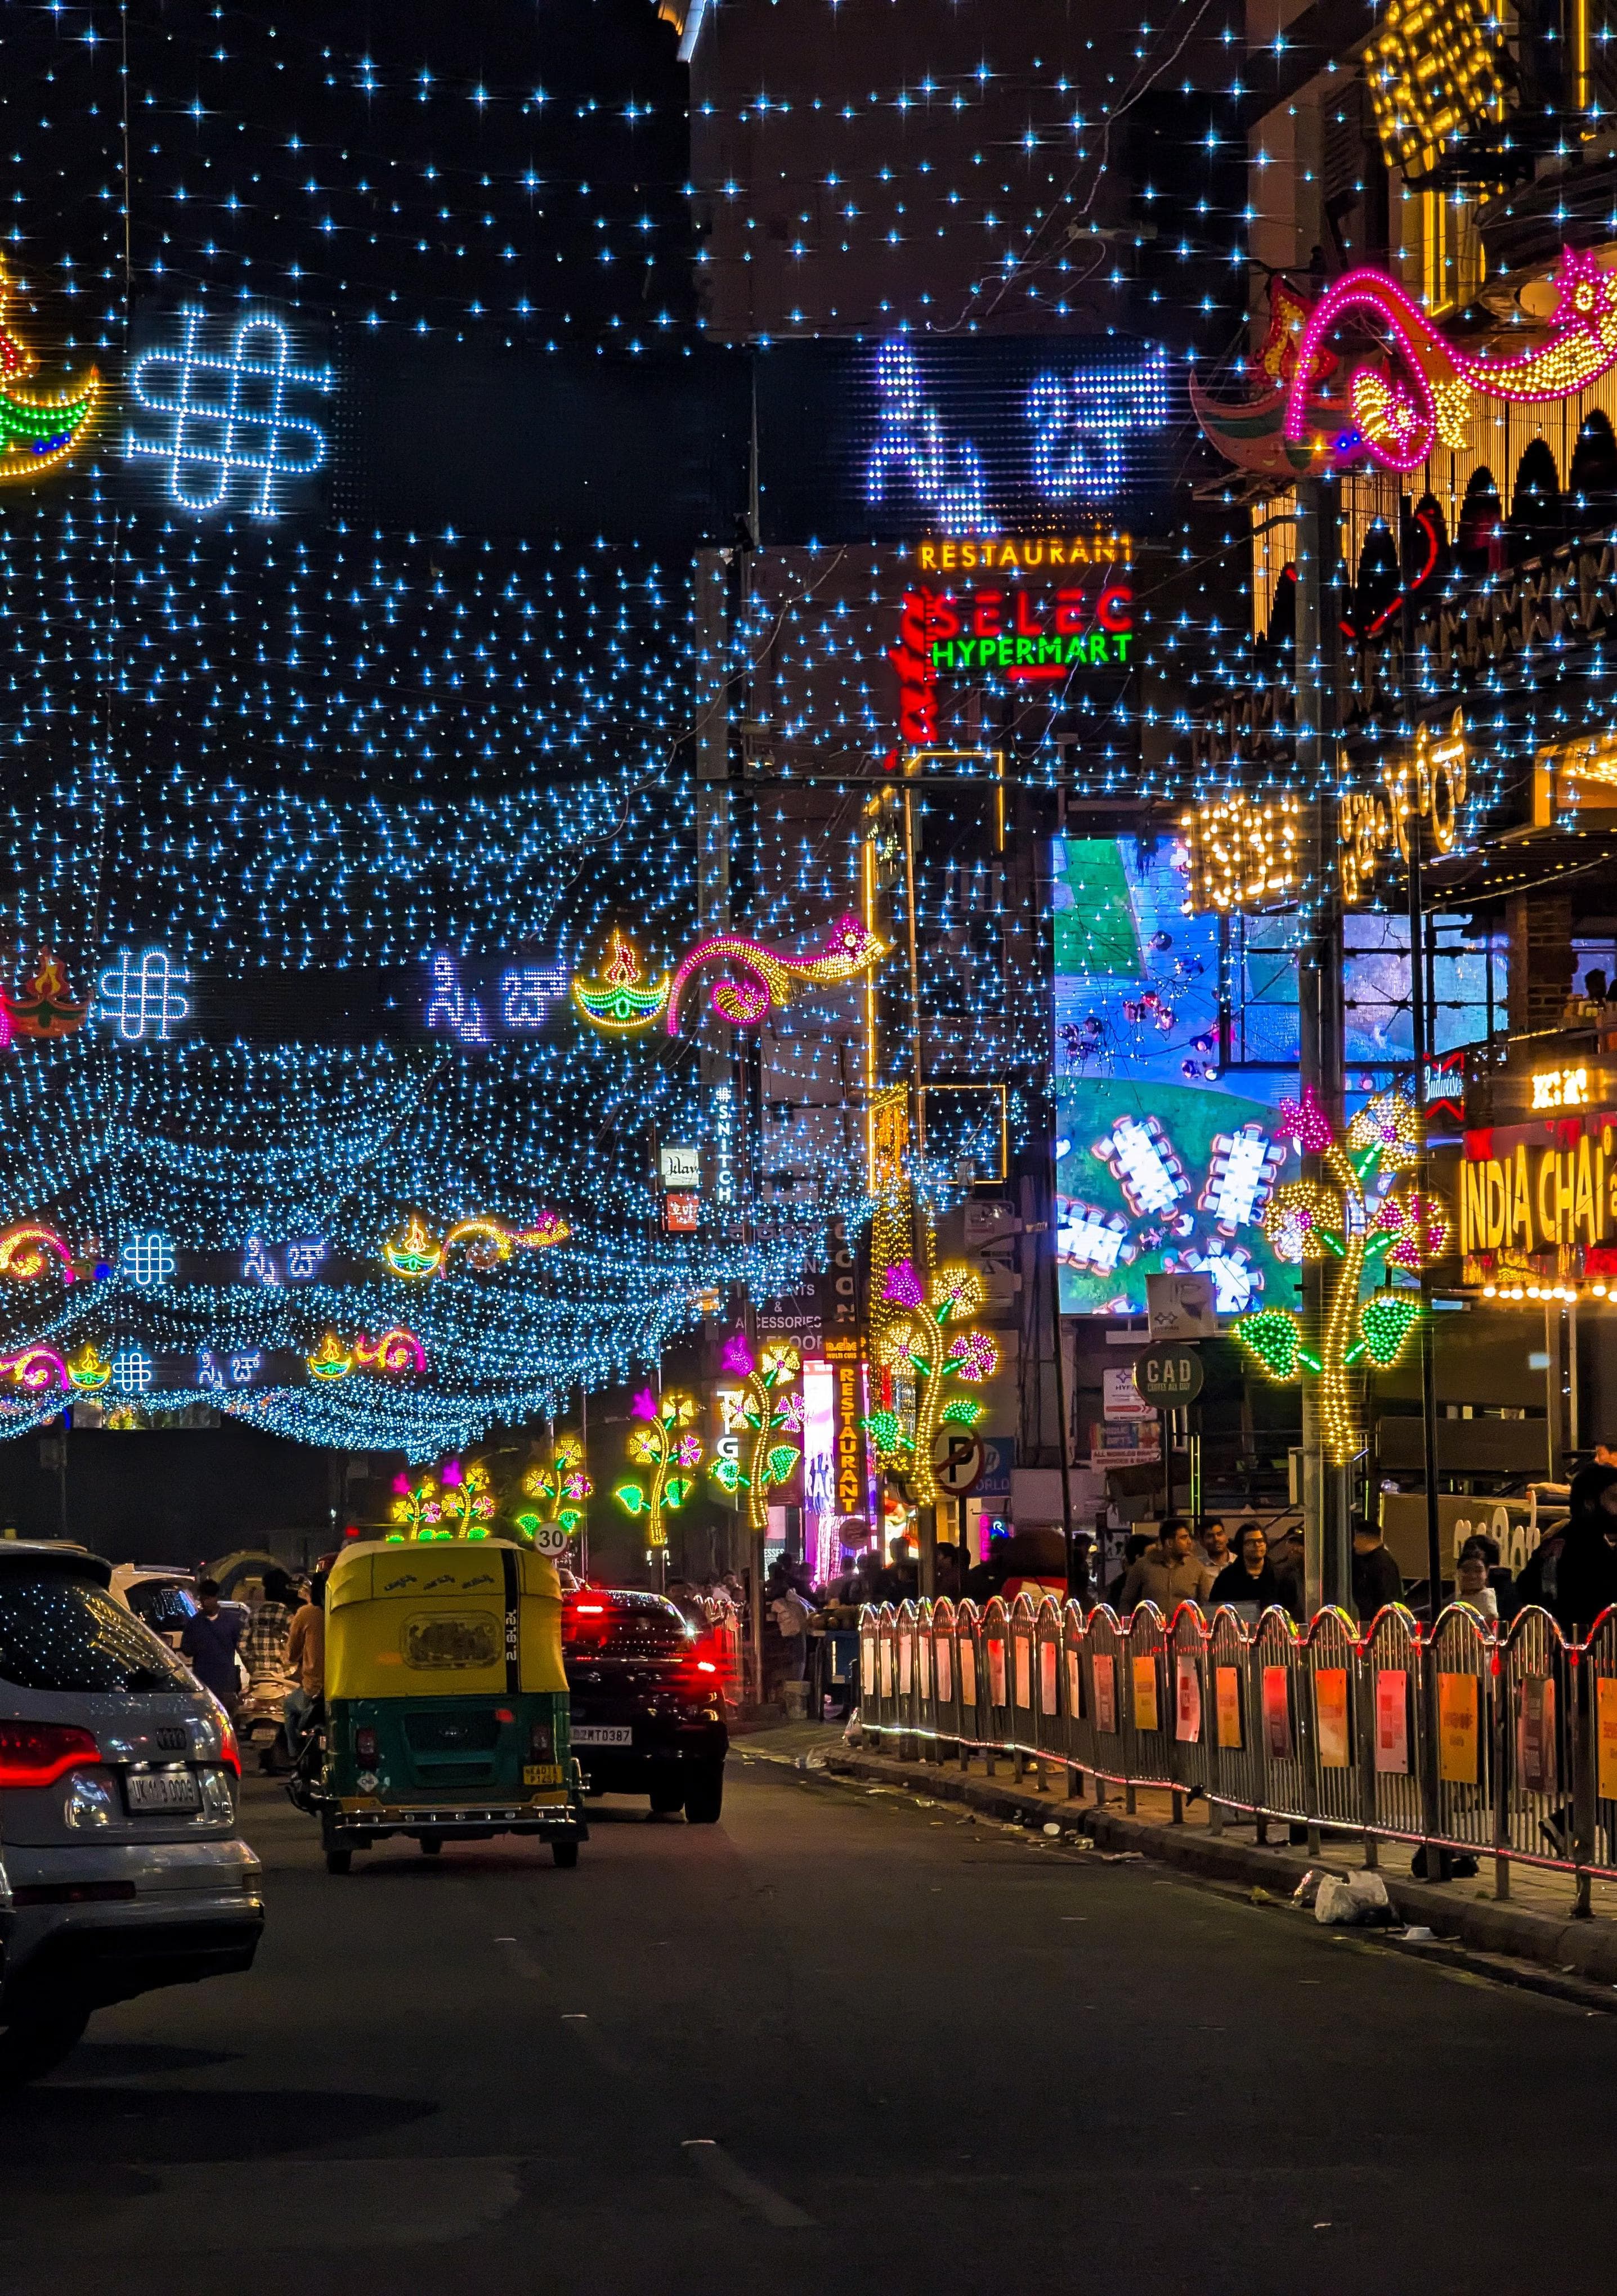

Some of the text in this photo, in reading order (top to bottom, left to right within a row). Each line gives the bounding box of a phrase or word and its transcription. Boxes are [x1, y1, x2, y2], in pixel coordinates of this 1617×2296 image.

[932, 634, 1132, 667] HYPERMART
[718, 1105, 731, 1201] SNITCH
[1460, 1143, 1533, 1255] INDIA
[1539, 1134, 1603, 1248] CHAI
[774, 1302, 782, 1312] &
[735, 1316, 822, 1329] ACESSORIES
[1147, 1359, 1191, 1383] CAD
[839, 1368, 858, 1512] RESTAURANT
[975, 1478, 1010, 1491] ORLD
[539, 1530, 563, 1548] 30
